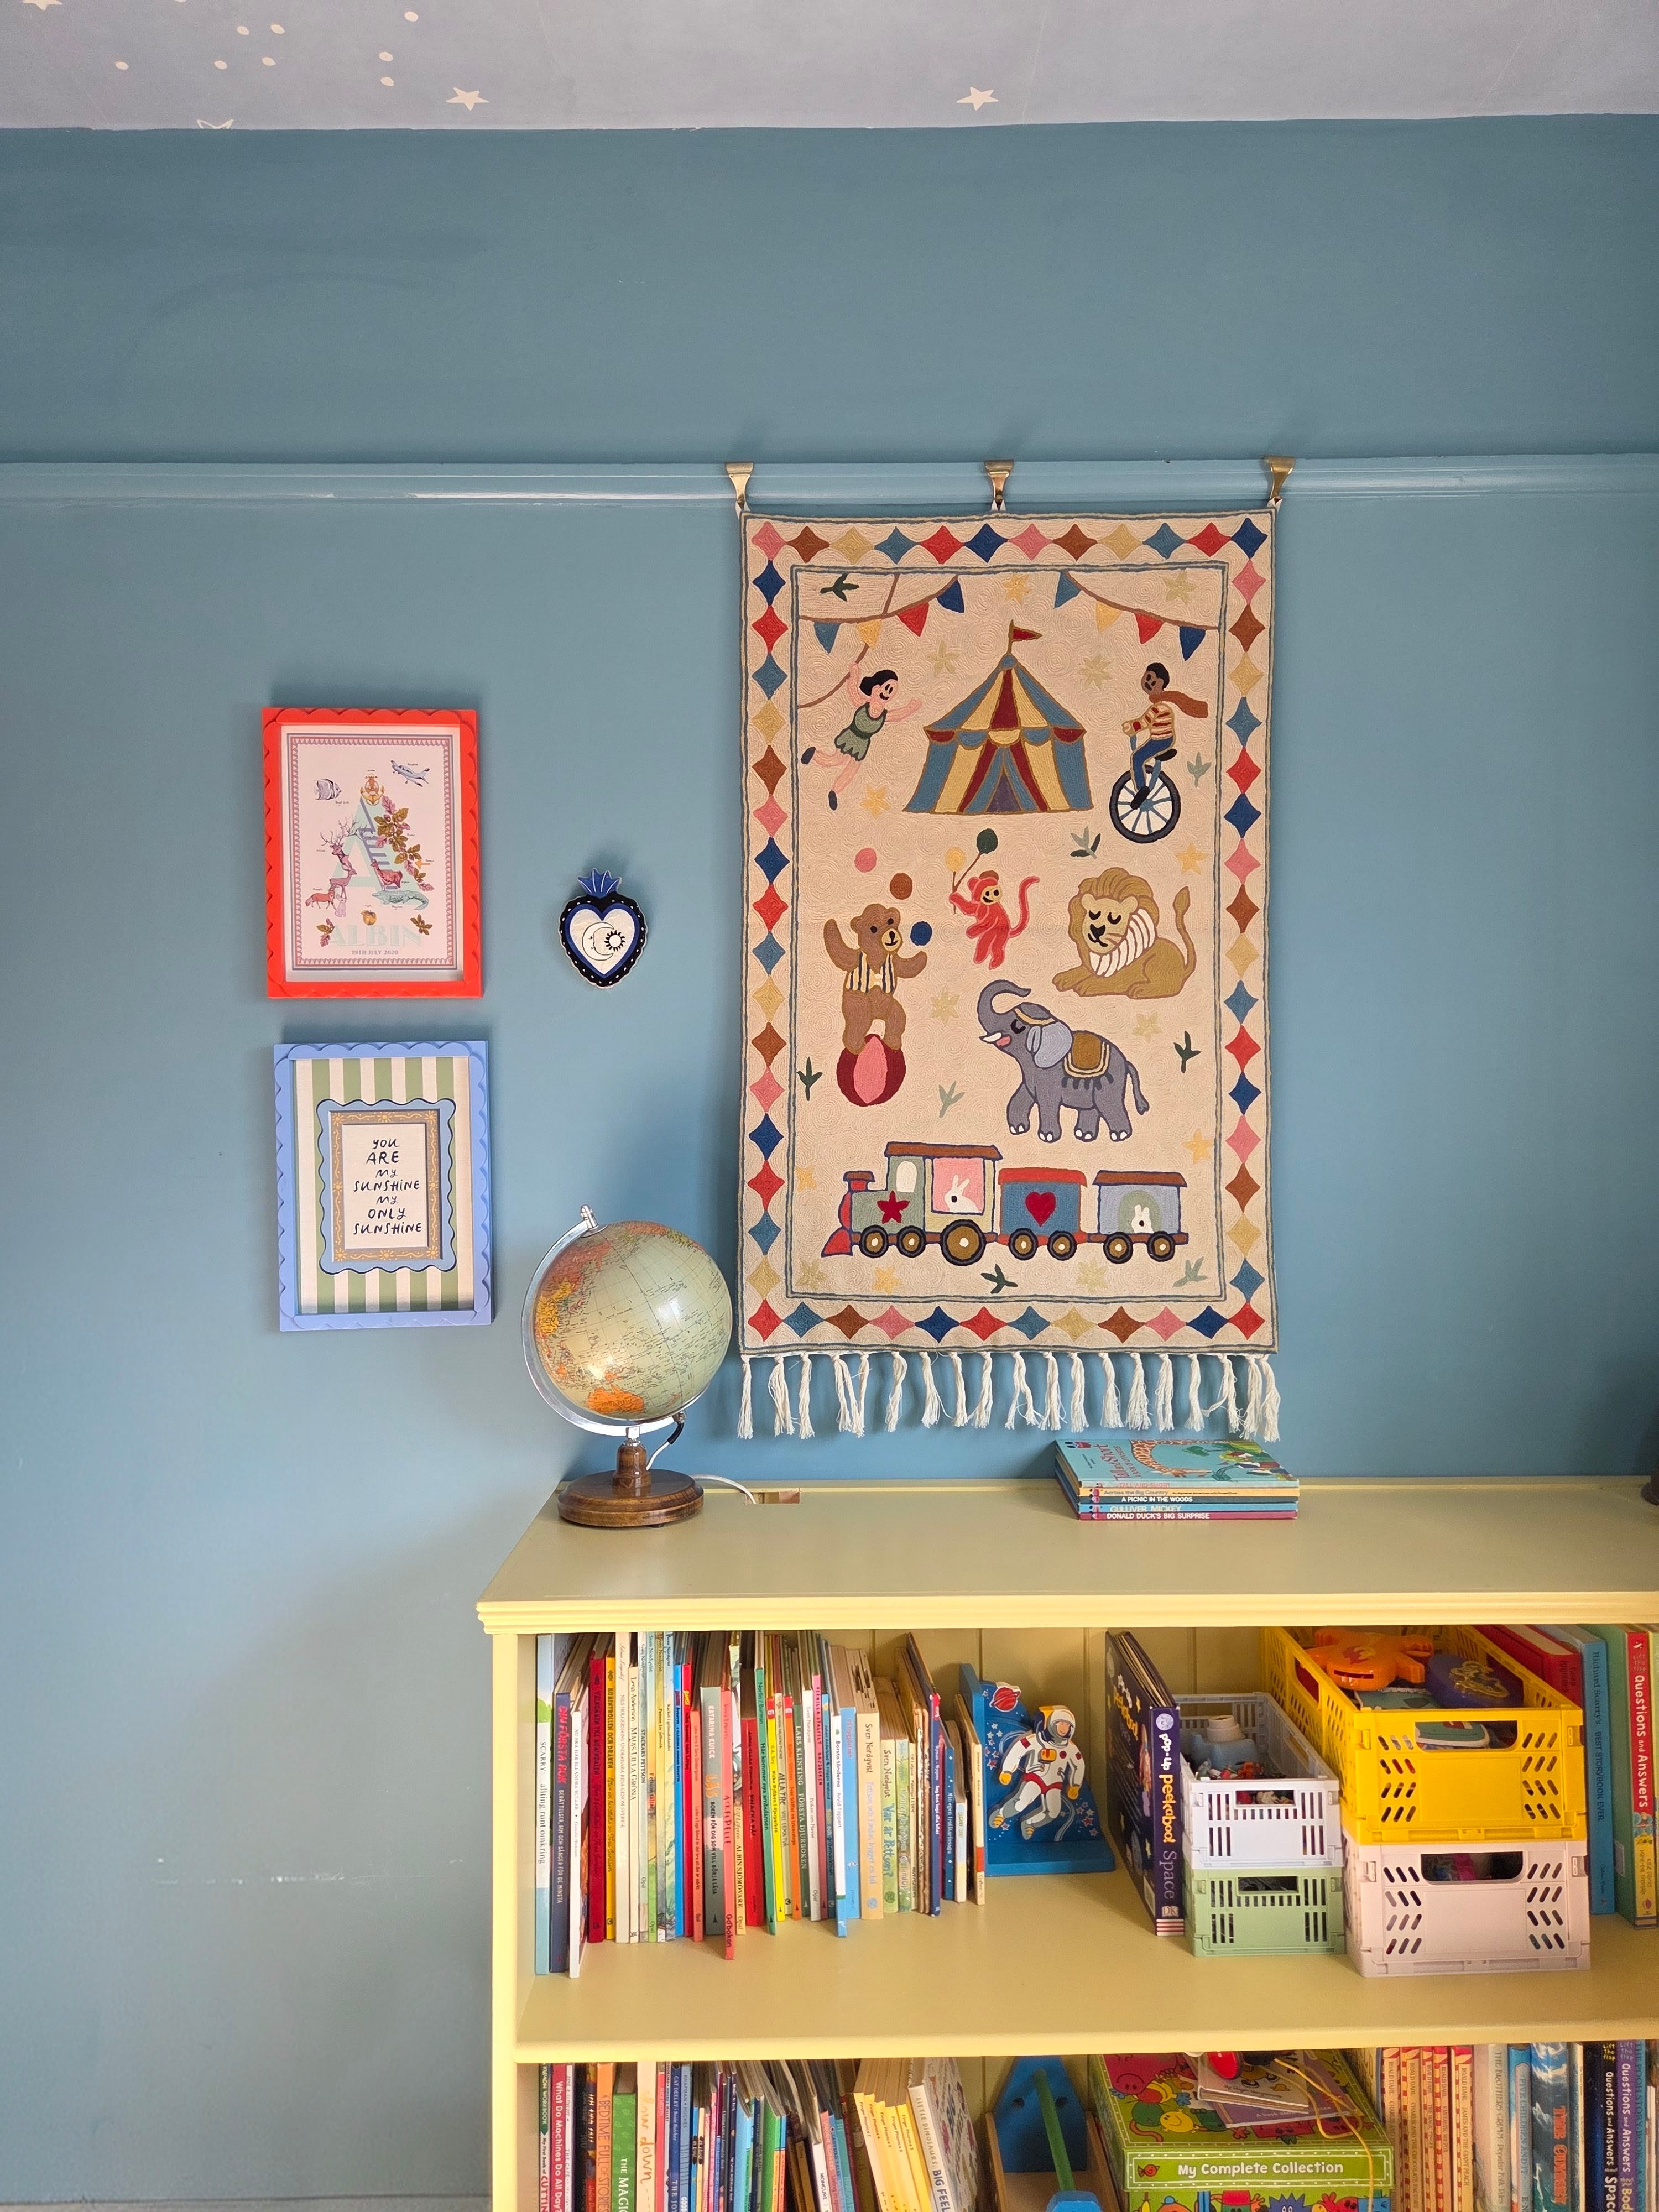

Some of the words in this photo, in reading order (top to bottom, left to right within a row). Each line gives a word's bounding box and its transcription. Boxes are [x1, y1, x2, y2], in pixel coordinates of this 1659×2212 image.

[331, 925, 421, 947] ALBIN
[366, 1151, 400, 1165] ARE
[368, 1208, 407, 1220] ONLY
[1592, 1651, 1601, 1688] Richard
[1593, 1689, 1604, 1725] Scarry's
[1634, 1675, 1647, 1737] Questions
[865, 1723, 873, 1740] Sven
[1594, 1731, 1603, 1750] BEST
[1637, 1740, 1646, 1752] and
[864, 1742, 873, 1773] Nordqvist
[705, 1774, 722, 1798] LÄS
[882, 1767, 892, 1798] Nordqvist
[1594, 1752, 1604, 1798] STORYBOOK
[1637, 1754, 1648, 1808] Answers
[539, 1783, 547, 1809] allting
[797, 1793, 806, 1822] FÖRSTA
[1159, 1773, 1176, 1844] peekaboo!
[883, 1803, 895, 1822] Var
[538, 1830, 547, 1864] omkring
[799, 1824, 807, 1869] DJURBOKEN
[884, 1826, 891, 1837] är
[883, 1839, 895, 1877] Pettson?
[736, 1867, 744, 1908] SJÖRÖVARE
[1158, 1850, 1176, 1899] Space
[735, 1916, 744, 1929] Opal
[1494, 2051, 1503, 2068] THE
[555, 2081, 564, 2103] What
[1494, 2069, 1504, 2111] BROTHERS
[1519, 2078, 1527, 2099] FIVE
[1605, 2072, 1615, 2116] Questions
[1621, 2063, 1632, 2115] Questions
[555, 2106, 563, 2117] Do
[597, 2100, 611, 2142] BEDTIME
[1519, 2100, 1528, 2146] CHILDREN
[1552, 2106, 1567, 2140] THE
[1635, 2095, 1644, 2127] STORY
[555, 2120, 563, 2162] Machines
[598, 2145, 611, 2166] FULL
[916, 2098, 927, 2123] LITTLE
[932, 2169, 945, 2186] BIG
[1496, 2143, 1505, 2171] Popular
[1520, 2146, 1528, 2165] AND
[1606, 2127, 1615, 2166] Answers
[1622, 2128, 1632, 2173] Answers
[1635, 2130, 1644, 2160] BOOK
[555, 2164, 562, 2176] Do
[639, 2137, 655, 2184] down
[1178, 2164, 1196, 2178] My
[1201, 2162, 1268, 2177] Complete
[1272, 2161, 1343, 2173] Collection
[1553, 2144, 1567, 2205] ODYSSEY
[555, 2178, 563, 2189] All
[597, 2177, 610, 2212] STORIES
[1604, 2176, 1618, 2212] Space
